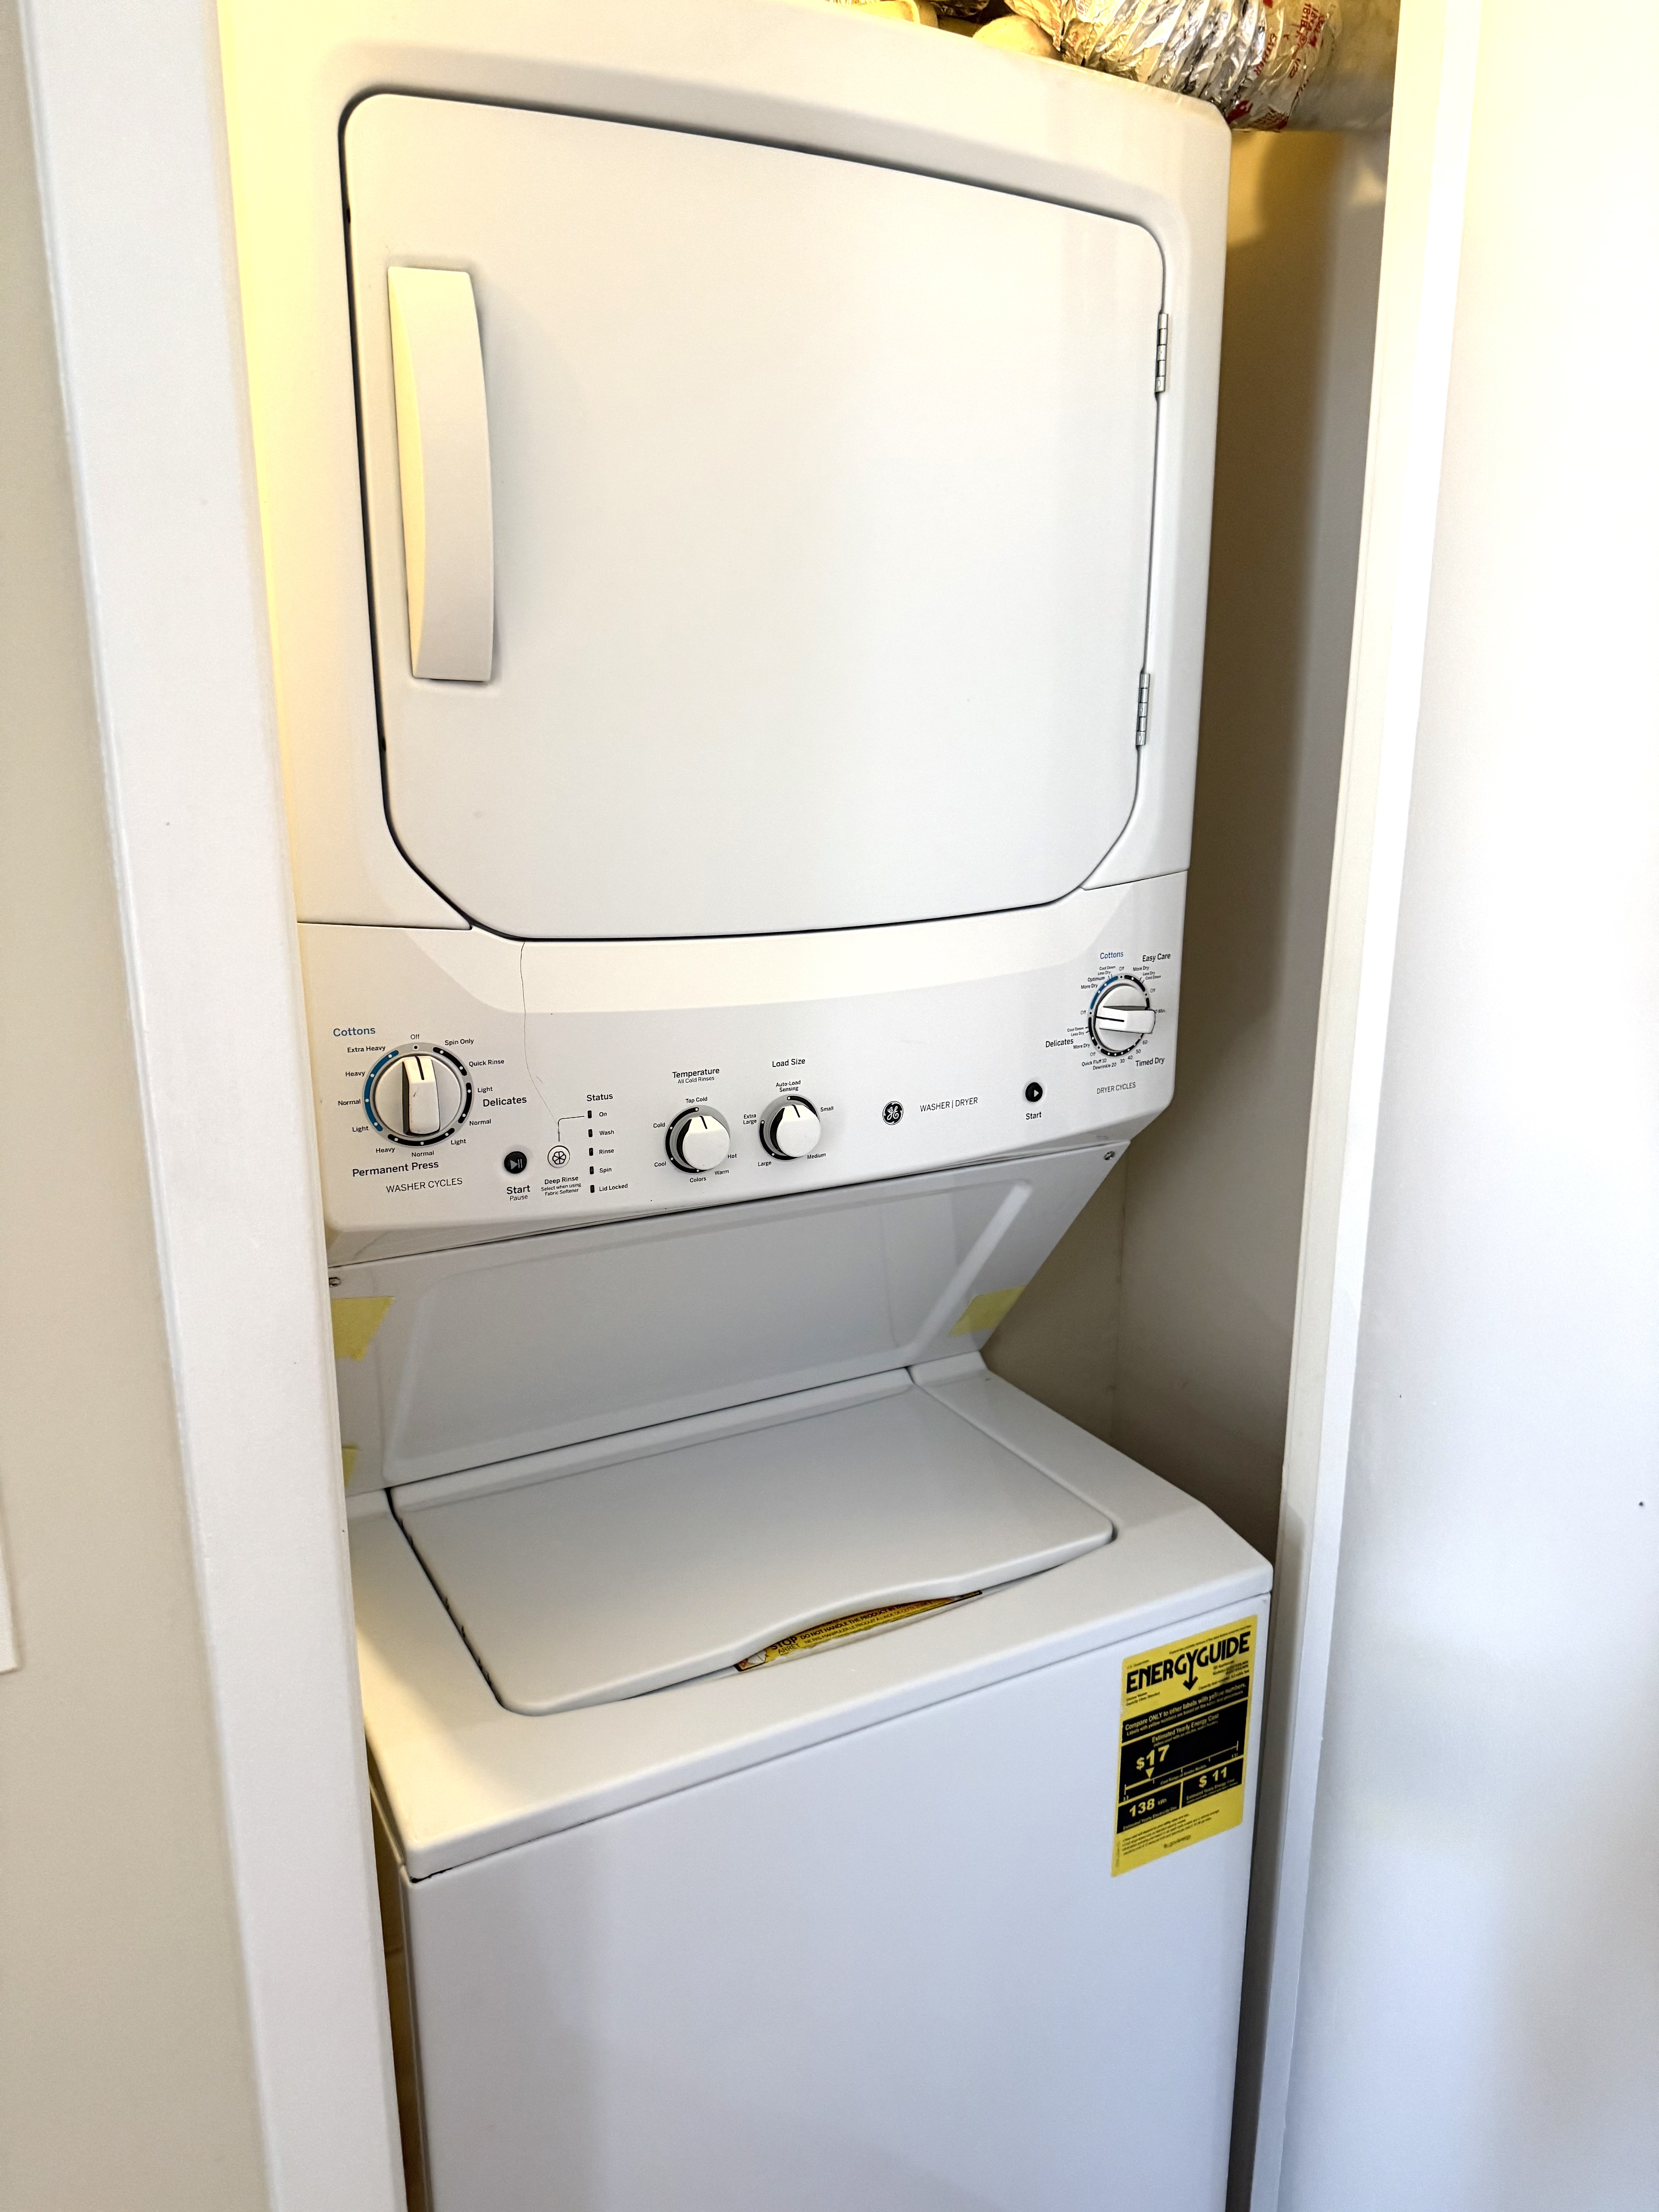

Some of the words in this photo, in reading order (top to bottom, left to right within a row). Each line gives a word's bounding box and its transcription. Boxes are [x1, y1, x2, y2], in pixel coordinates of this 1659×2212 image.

[333, 1027, 376, 1037] Cottons
[1046, 1039, 1073, 1048] Delicates
[772, 1059, 789, 1067] Load
[1135, 1058, 1154, 1067] Timed
[672, 1068, 720, 1079] Temperature
[1097, 1085, 1115, 1094] DRYER
[1115, 1082, 1136, 1091] CYCLES
[483, 1096, 527, 1107] Delicates
[587, 1094, 613, 1102] Status
[920, 1101, 950, 1112] WASHER
[955, 1097, 978, 1107] DRYER
[1026, 1111, 1042, 1120] Start
[352, 1163, 409, 1177] Permanent
[412, 1162, 439, 1171] Press
[386, 1182, 426, 1193] WASHER
[428, 1177, 463, 1188] CYCLES
[507, 1185, 531, 1195] Start
[771, 1635, 797, 1650] STOP
[1126, 1631, 1251, 1694] ENERGYGUIDE
[1125, 1719, 1147, 1730] Compare
[1149, 1712, 1163, 1722] ONLY
[1183, 1700, 1197, 1709] labels
[1152, 1729, 1175, 1743] Estimated
[1176, 1724, 1190, 1733] Yearly
[1191, 1719, 1207, 1728] Energy
[1208, 1713, 1219, 1721] Cost
[1136, 1744, 1170, 1771] $17
[1199, 1776, 1207, 1788] $
[1212, 1767, 1227, 1781] 11
[1129, 1798, 1155, 1817] 138
